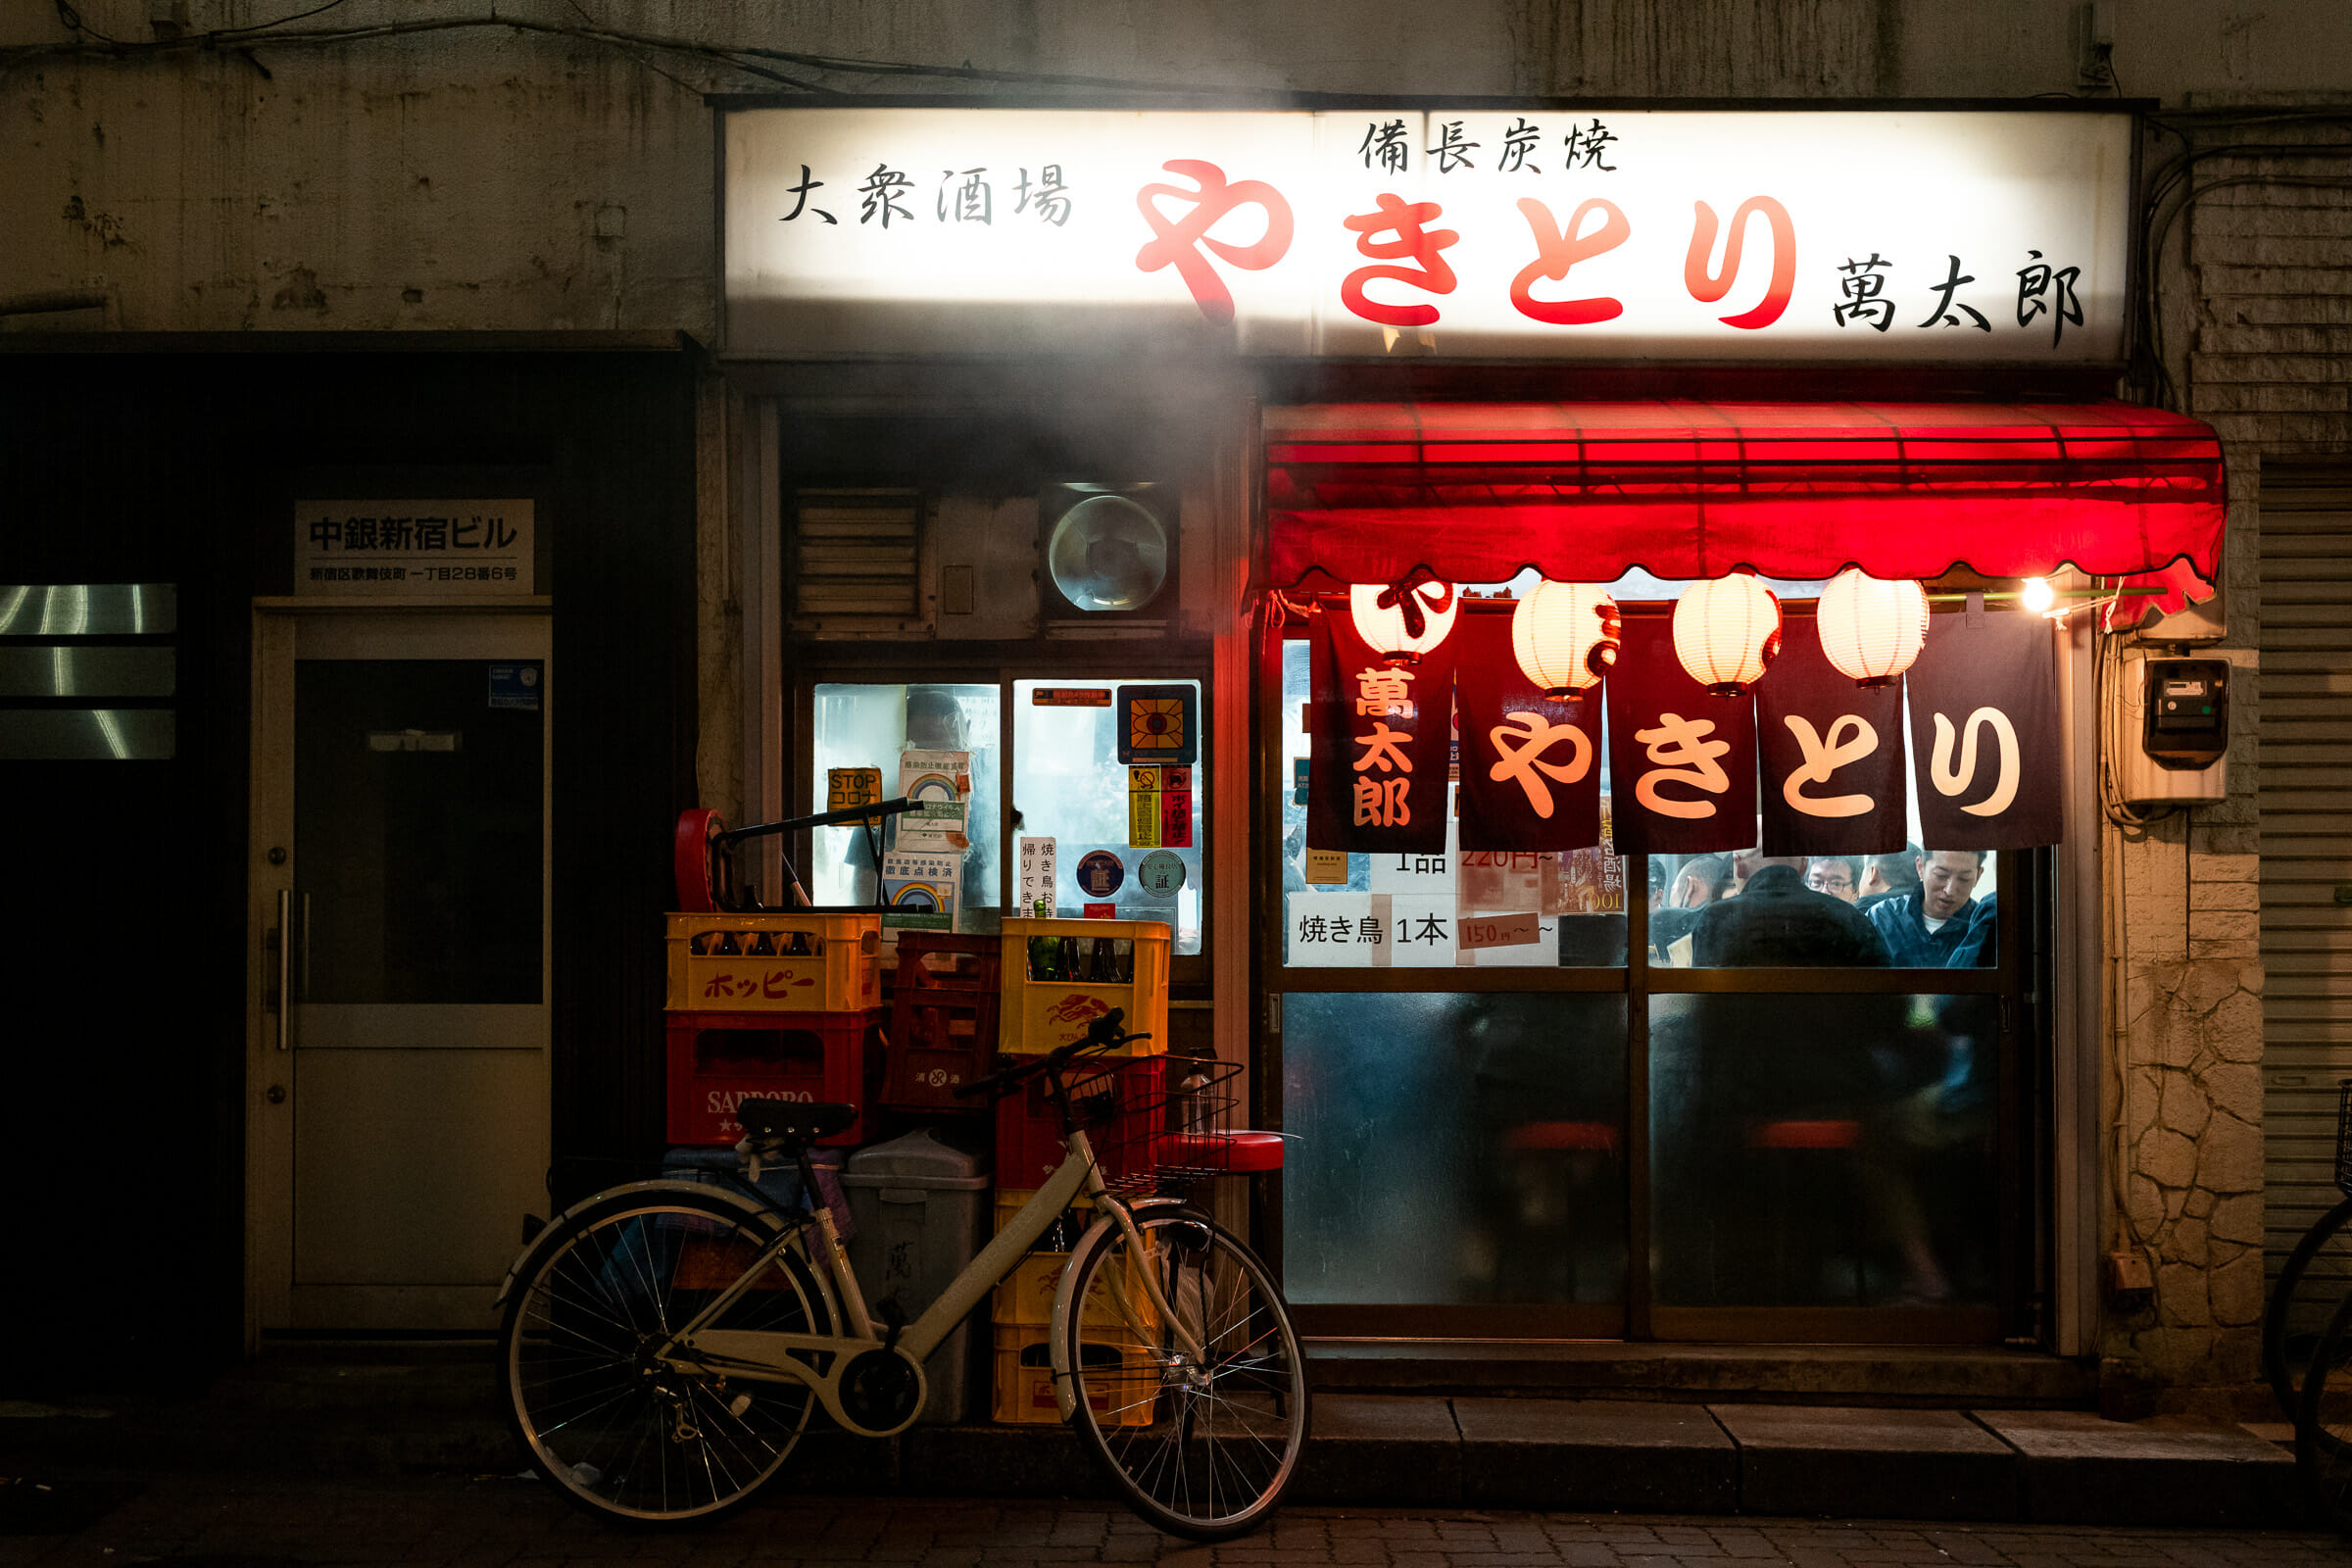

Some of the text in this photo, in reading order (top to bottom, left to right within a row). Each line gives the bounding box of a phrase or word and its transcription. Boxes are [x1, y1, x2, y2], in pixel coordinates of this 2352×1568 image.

[1358, 117, 1619, 174] 備長炭焼
[779, 164, 1071, 229] 大衆酒場
[1135, 159, 1796, 329] やきとり
[1833, 249, 2084, 351] 萬太郎
[310, 516, 517, 551] 中銀新宿ビル
[1352, 666, 1416, 827] 萬太郎
[1489, 706, 2021, 819] やきとり
[831, 774, 876, 789] STOP
[831, 790, 876, 806] コロナ
[1298, 914, 1384, 945] 焼き鳥
[1396, 912, 1448, 947] 1本
[705, 970, 814, 999] ホッピー
